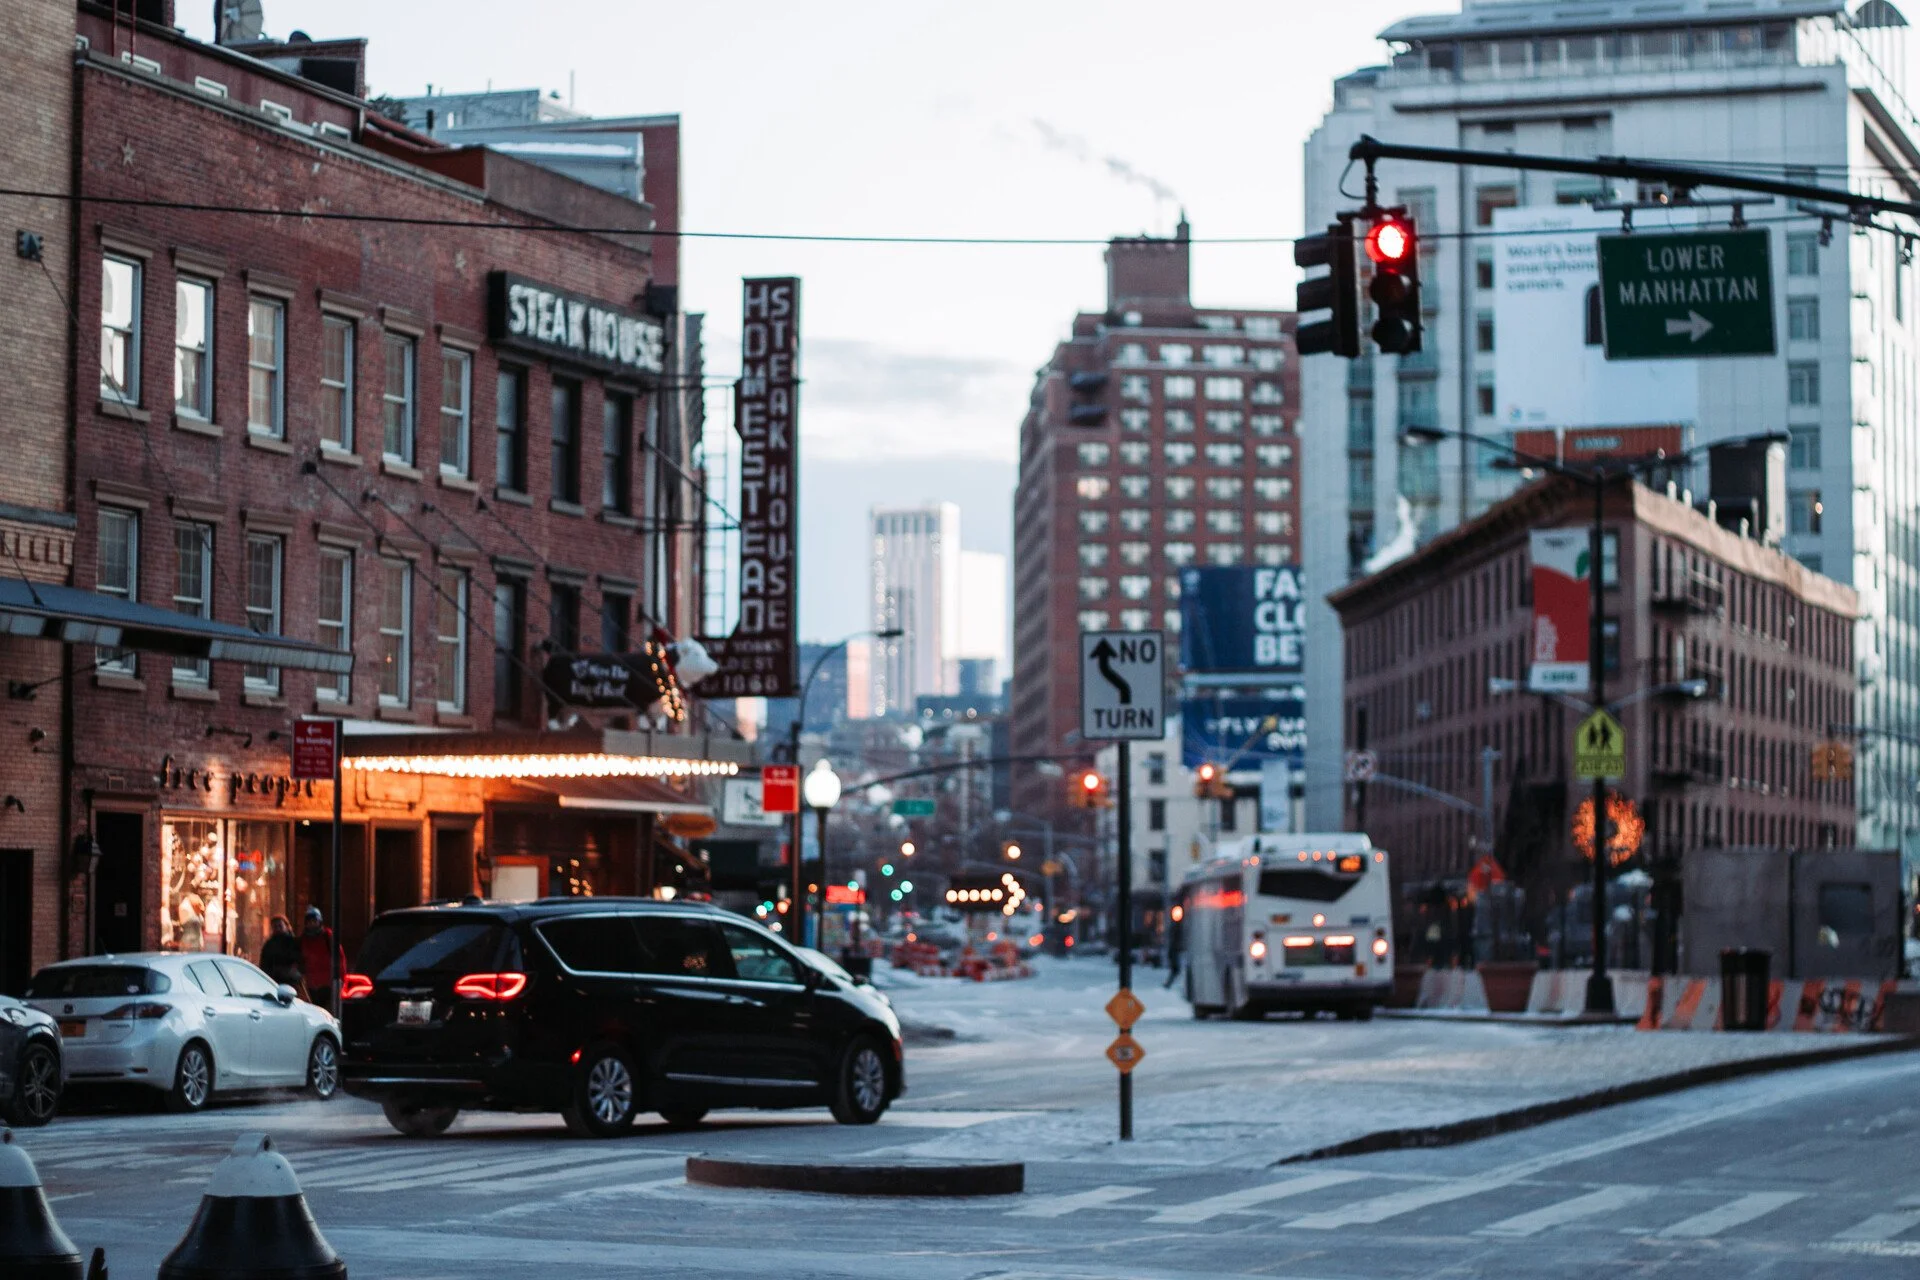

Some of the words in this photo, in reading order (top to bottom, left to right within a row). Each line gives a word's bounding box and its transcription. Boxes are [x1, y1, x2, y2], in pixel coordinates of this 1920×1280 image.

[1646, 244, 1725, 272] LOWER
[1618, 276, 1759, 305] MANHATTAN
[508, 283, 587, 350] STEAK
[588, 306, 664, 373] HOUSE
[767, 285, 790, 450] STEAK
[741, 283, 768, 633] HOMESTEAD
[767, 464, 788, 631] HOUSE
[1120, 638, 1157, 664] NO
[1255, 634, 1306, 665] BE
[1094, 707, 1155, 729] TURN
[160, 752, 212, 792] free
